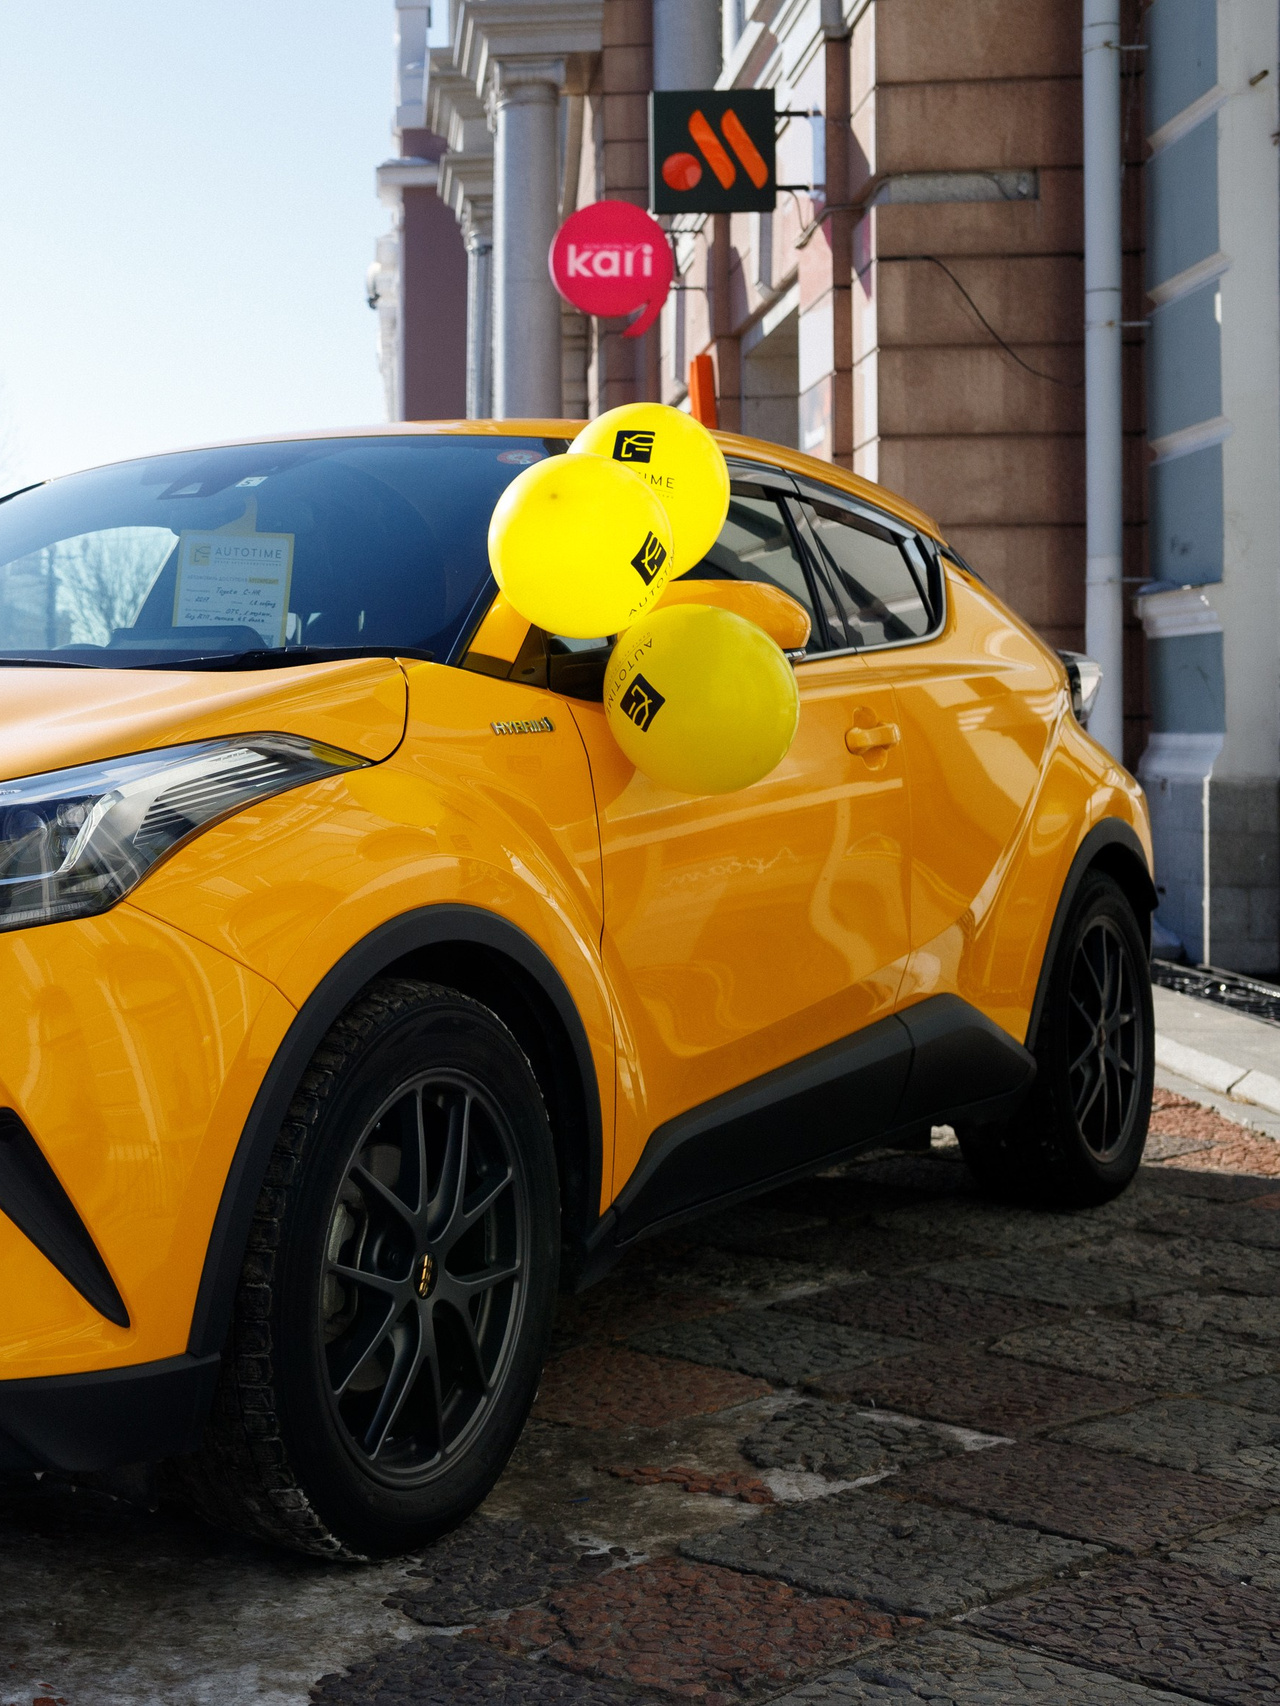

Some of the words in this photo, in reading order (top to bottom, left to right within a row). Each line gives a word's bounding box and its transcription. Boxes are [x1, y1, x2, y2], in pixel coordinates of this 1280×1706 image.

[567, 243, 654, 277] kari
[215, 547, 282, 559] AUTOTIME
[491, 716, 554, 736] HYBRID
